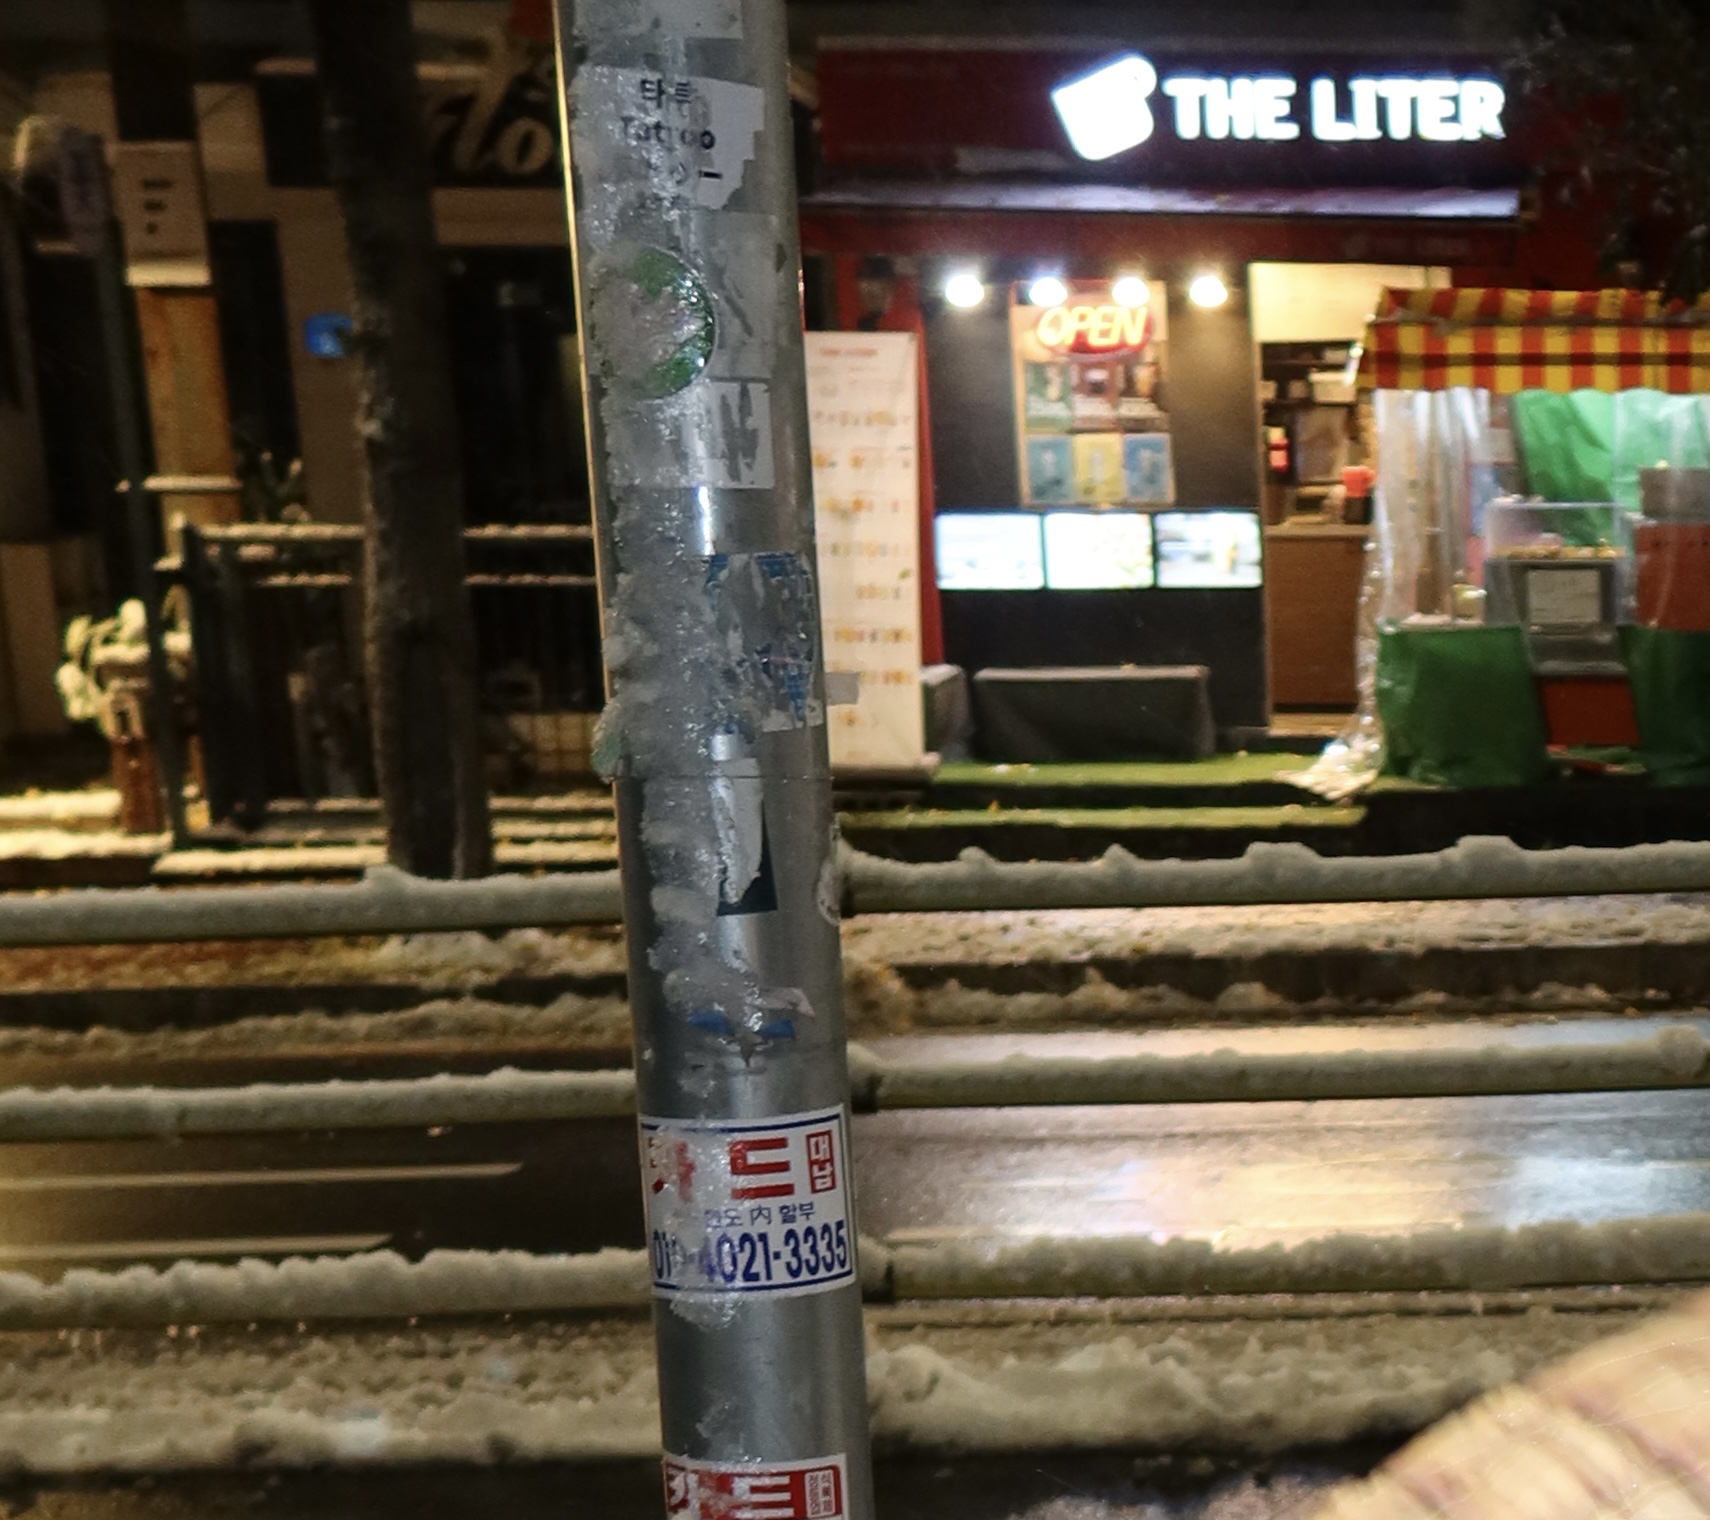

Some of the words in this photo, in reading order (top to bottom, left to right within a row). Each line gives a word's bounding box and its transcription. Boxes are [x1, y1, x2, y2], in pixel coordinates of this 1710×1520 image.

[1162, 79, 1300, 140] THE
[1310, 79, 1506, 141] LITER
[1036, 304, 1149, 347] OPEN
